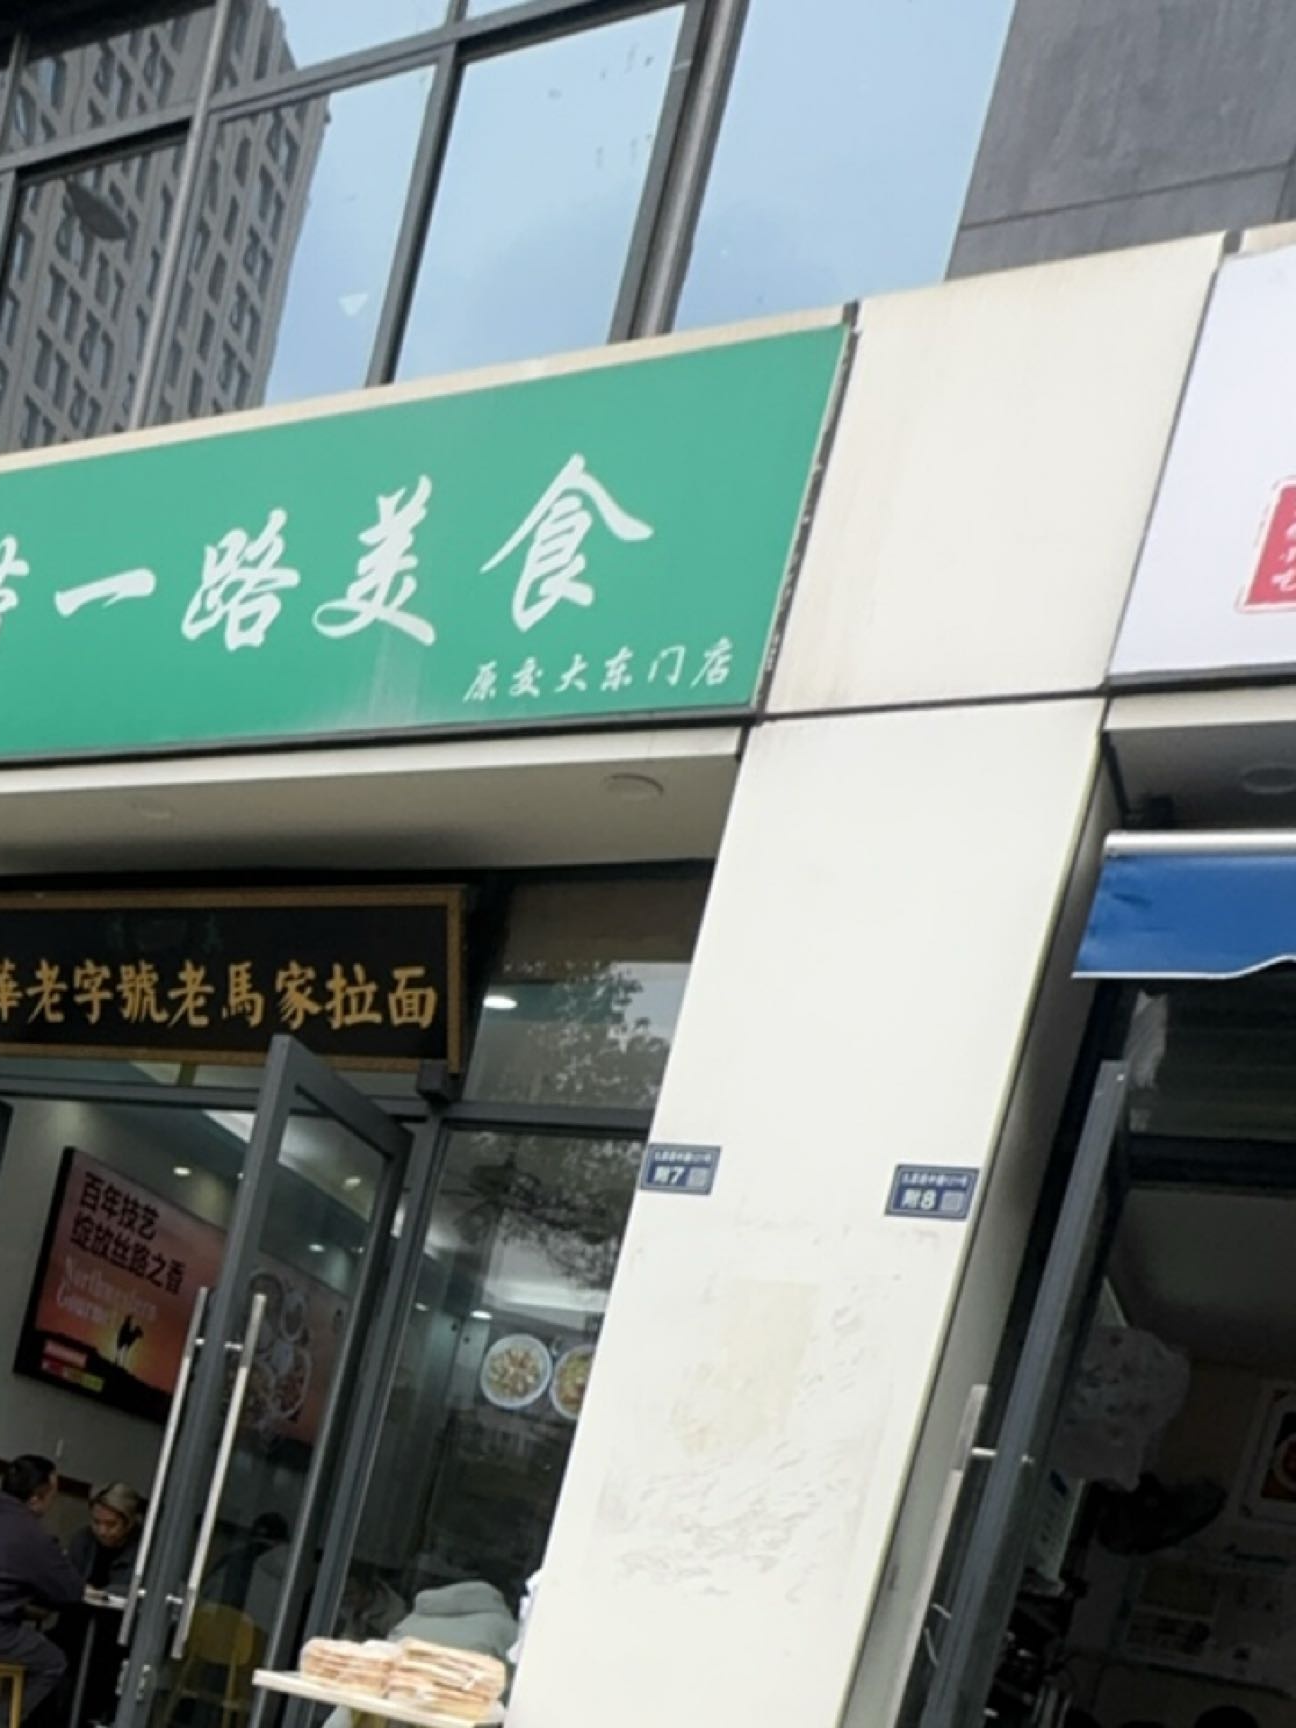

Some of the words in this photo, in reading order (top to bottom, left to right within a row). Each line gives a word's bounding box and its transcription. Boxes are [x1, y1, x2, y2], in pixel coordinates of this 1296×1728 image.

[462, 636, 734, 703] 原交大东门店
[78, 1170, 160, 1241] 百年技艺
[70, 1210, 187, 1296] 绽放丝路之香
